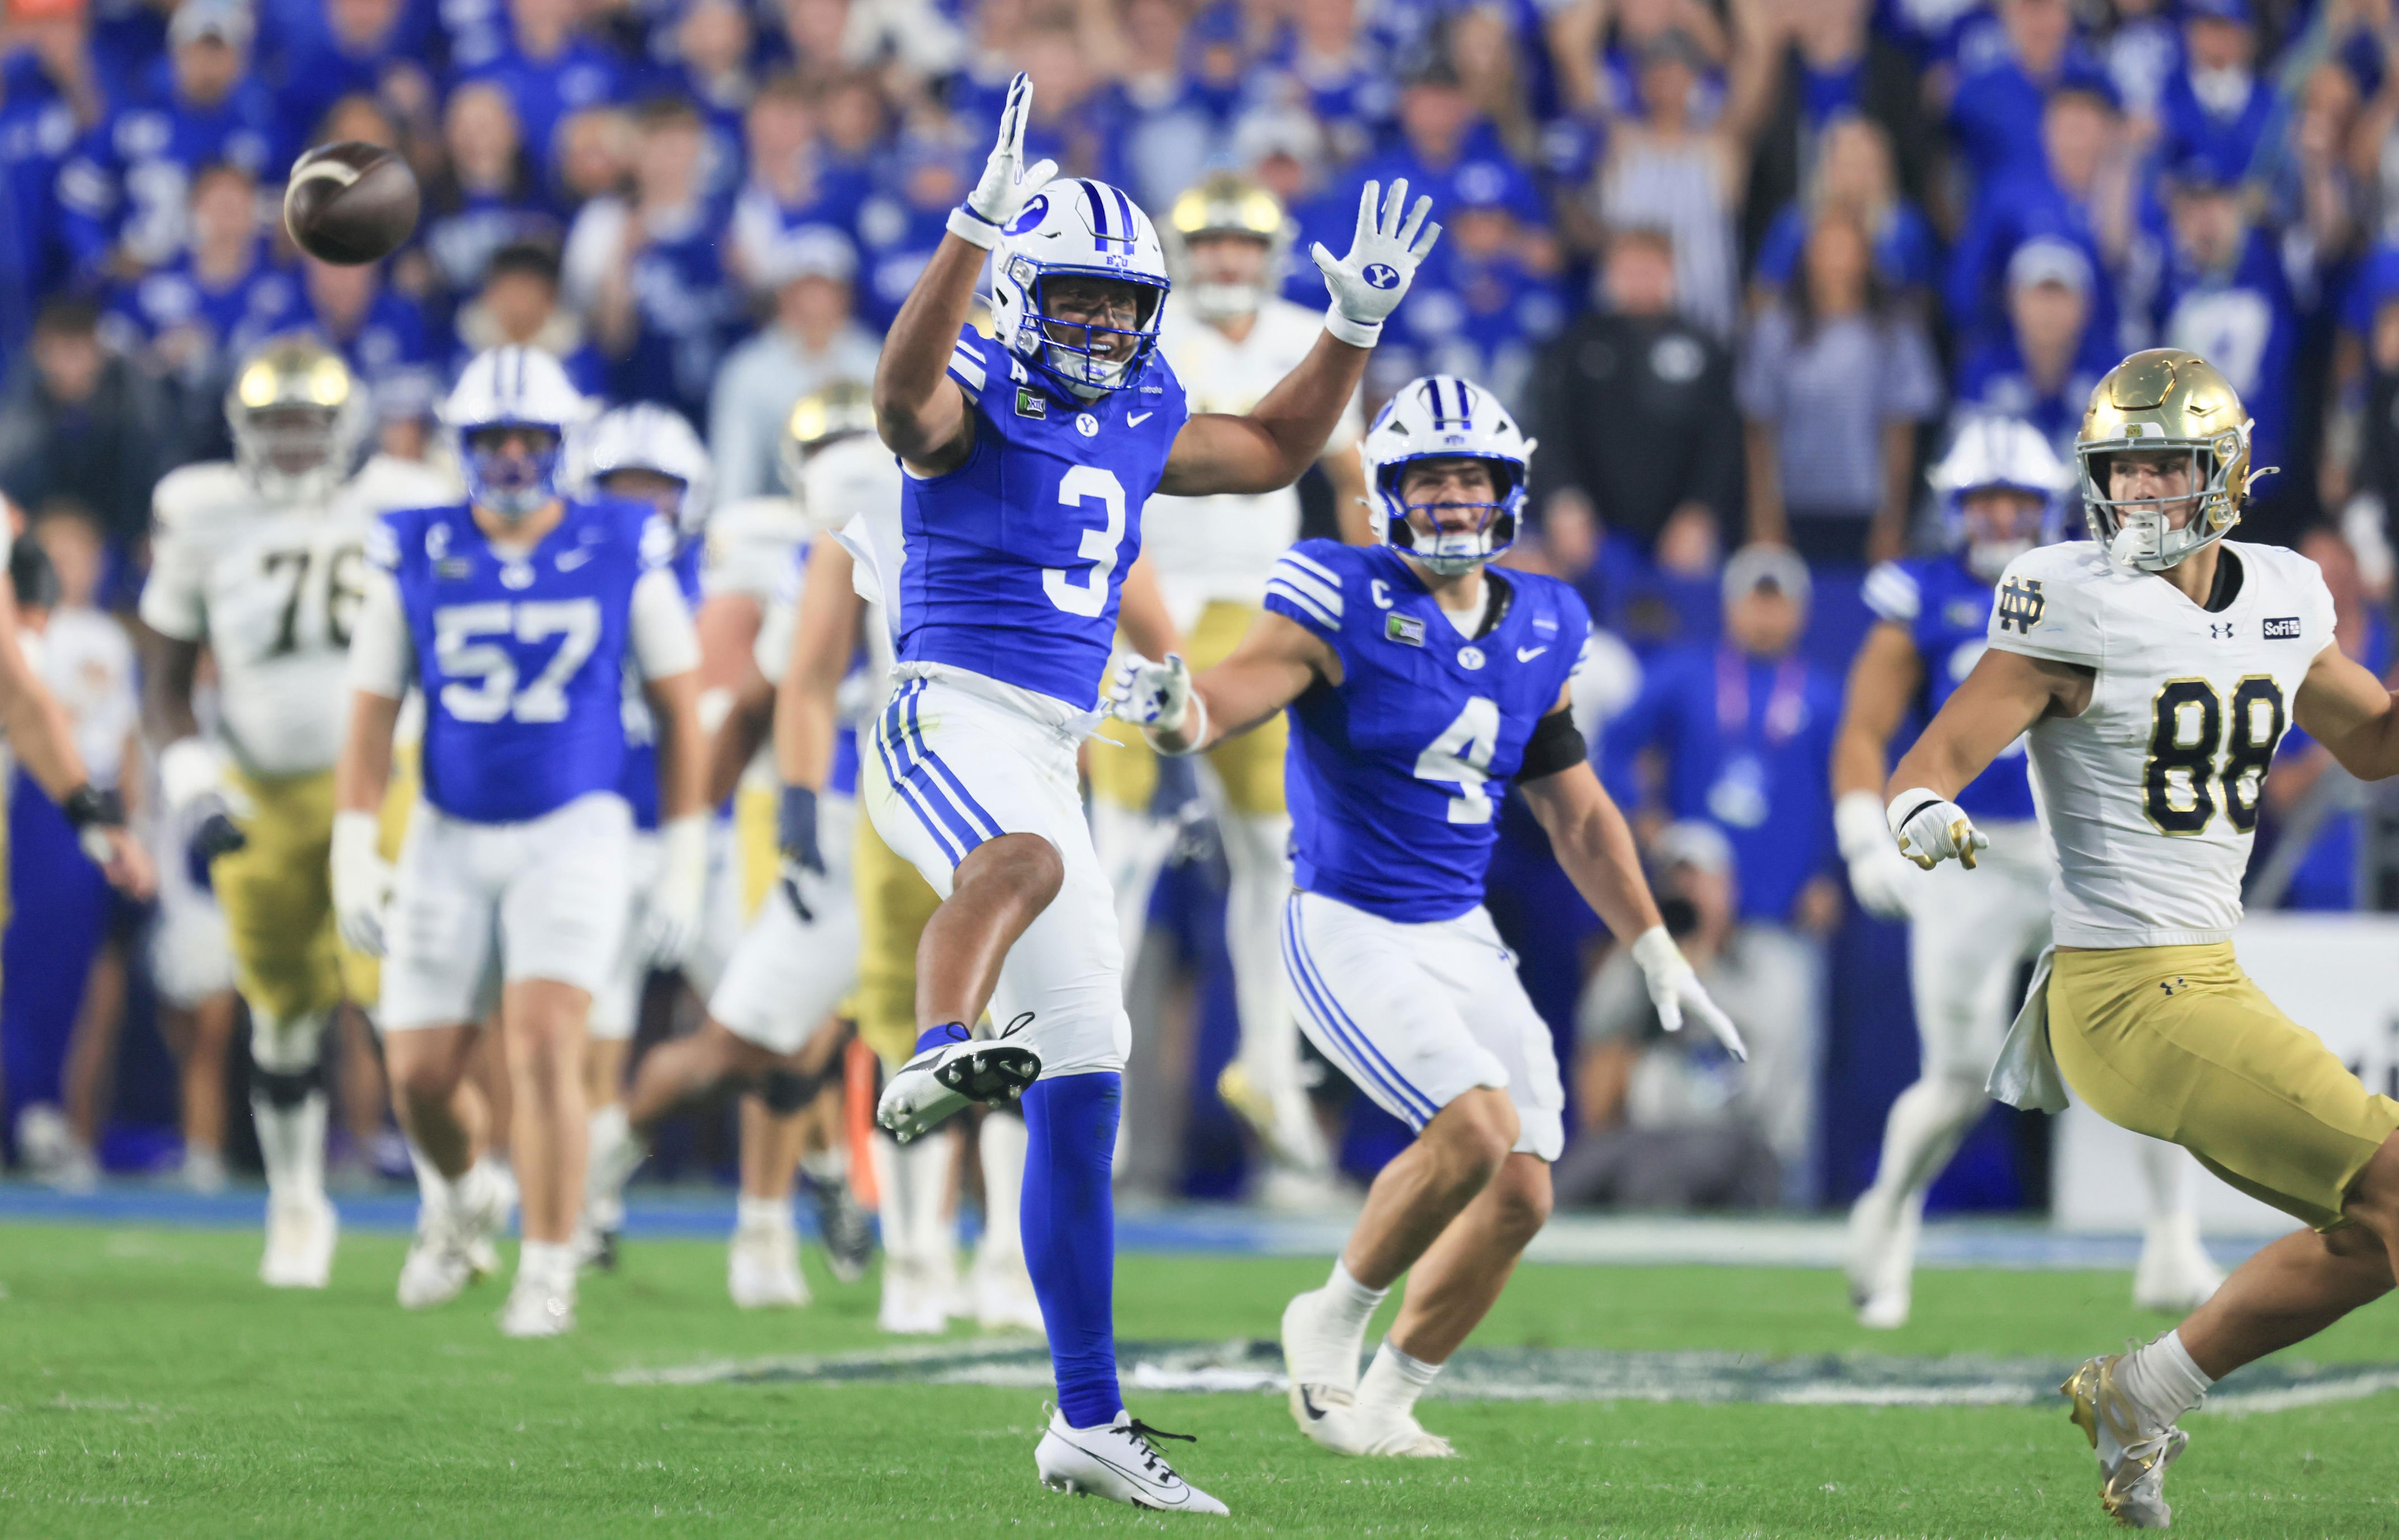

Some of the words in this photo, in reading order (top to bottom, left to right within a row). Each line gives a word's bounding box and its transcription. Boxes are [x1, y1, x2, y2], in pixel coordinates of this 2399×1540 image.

[1370, 265, 1396, 288] Y
[1009, 354, 1029, 385] A
[1081, 417, 1094, 433] Y
[1042, 464, 1125, 617] 3
[1371, 578, 1394, 610] C
[2264, 620, 2289, 636] SoFi
[433, 597, 603, 724] 57
[1414, 695, 1500, 825] 4
[2142, 673, 2284, 837] 88
